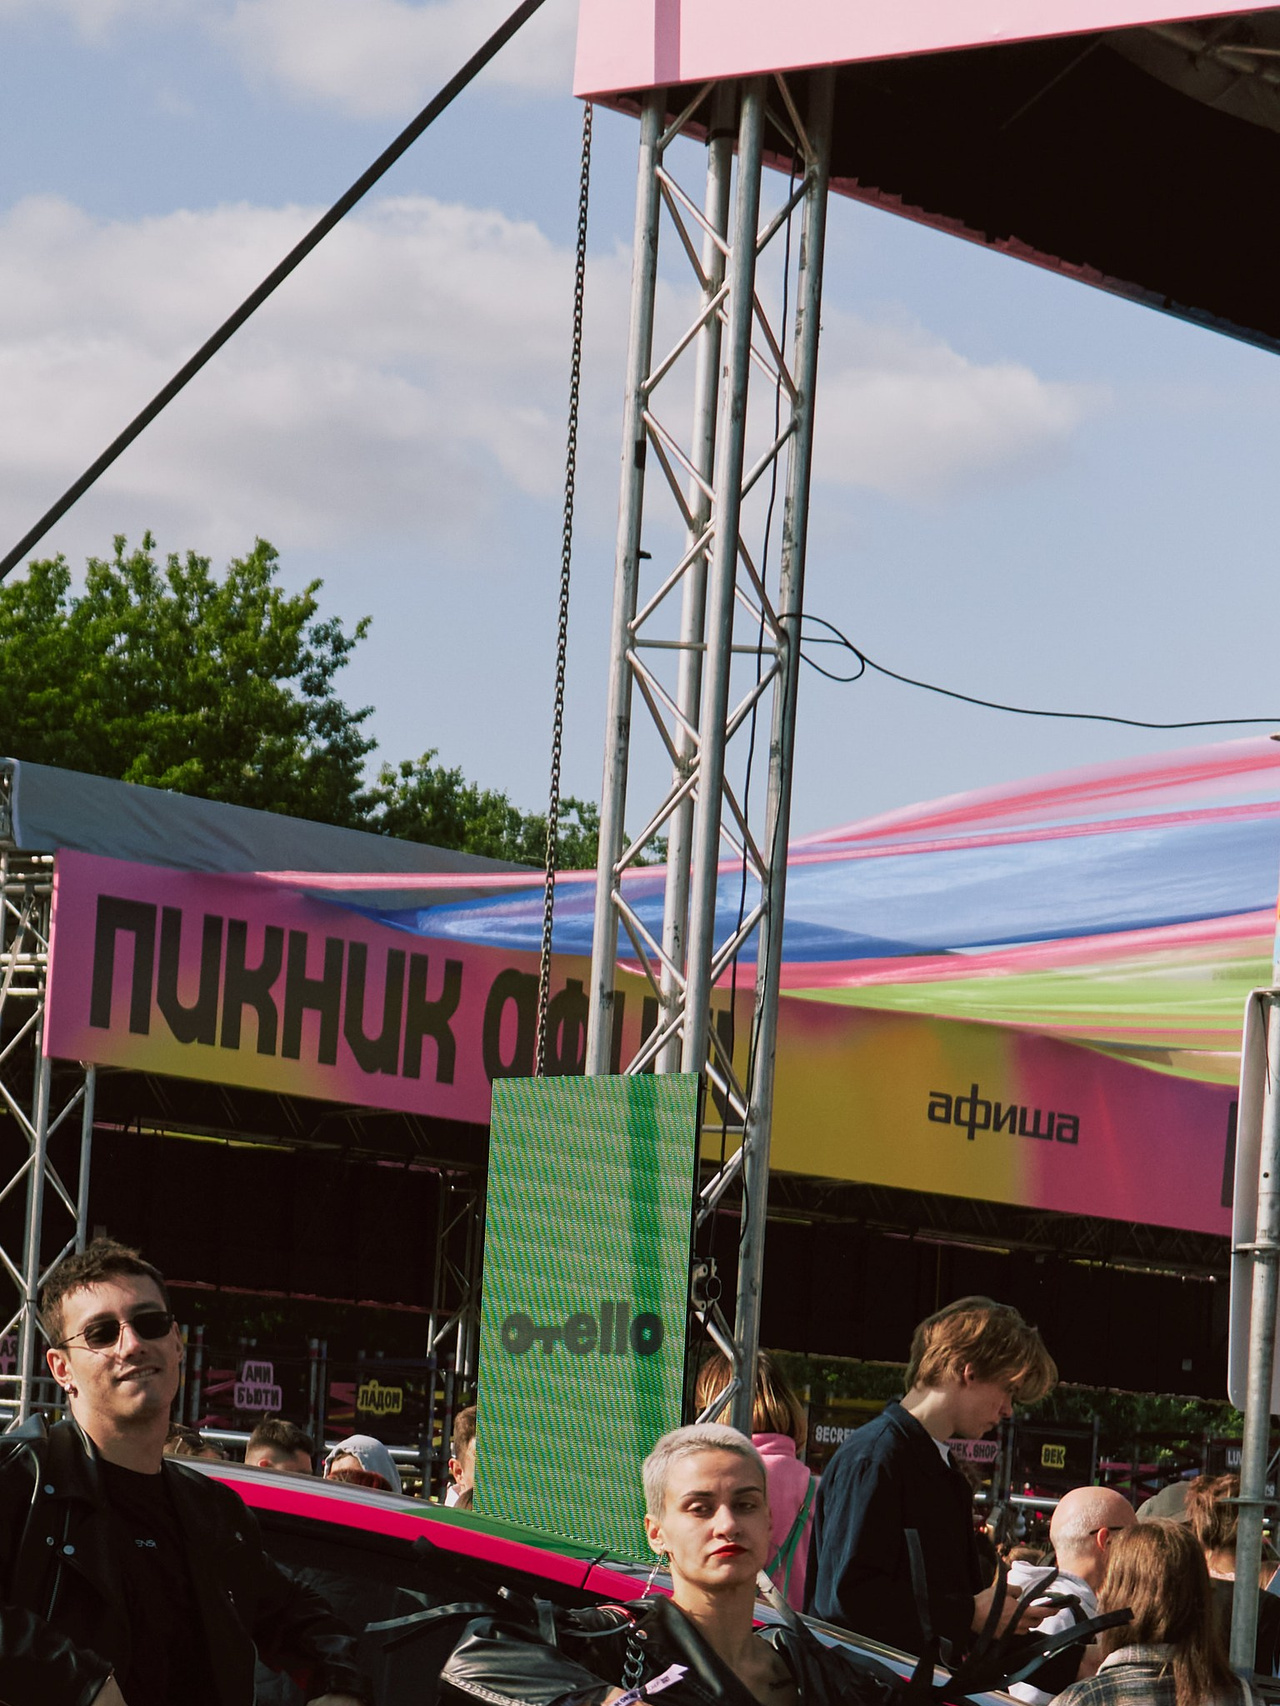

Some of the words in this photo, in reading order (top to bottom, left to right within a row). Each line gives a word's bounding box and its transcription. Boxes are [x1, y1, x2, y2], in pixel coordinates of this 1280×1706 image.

[90, 894, 463, 1086] ПИКНИК
[927, 1083, 1080, 1145] афиша
[815, 1424, 855, 1444] SECRE
